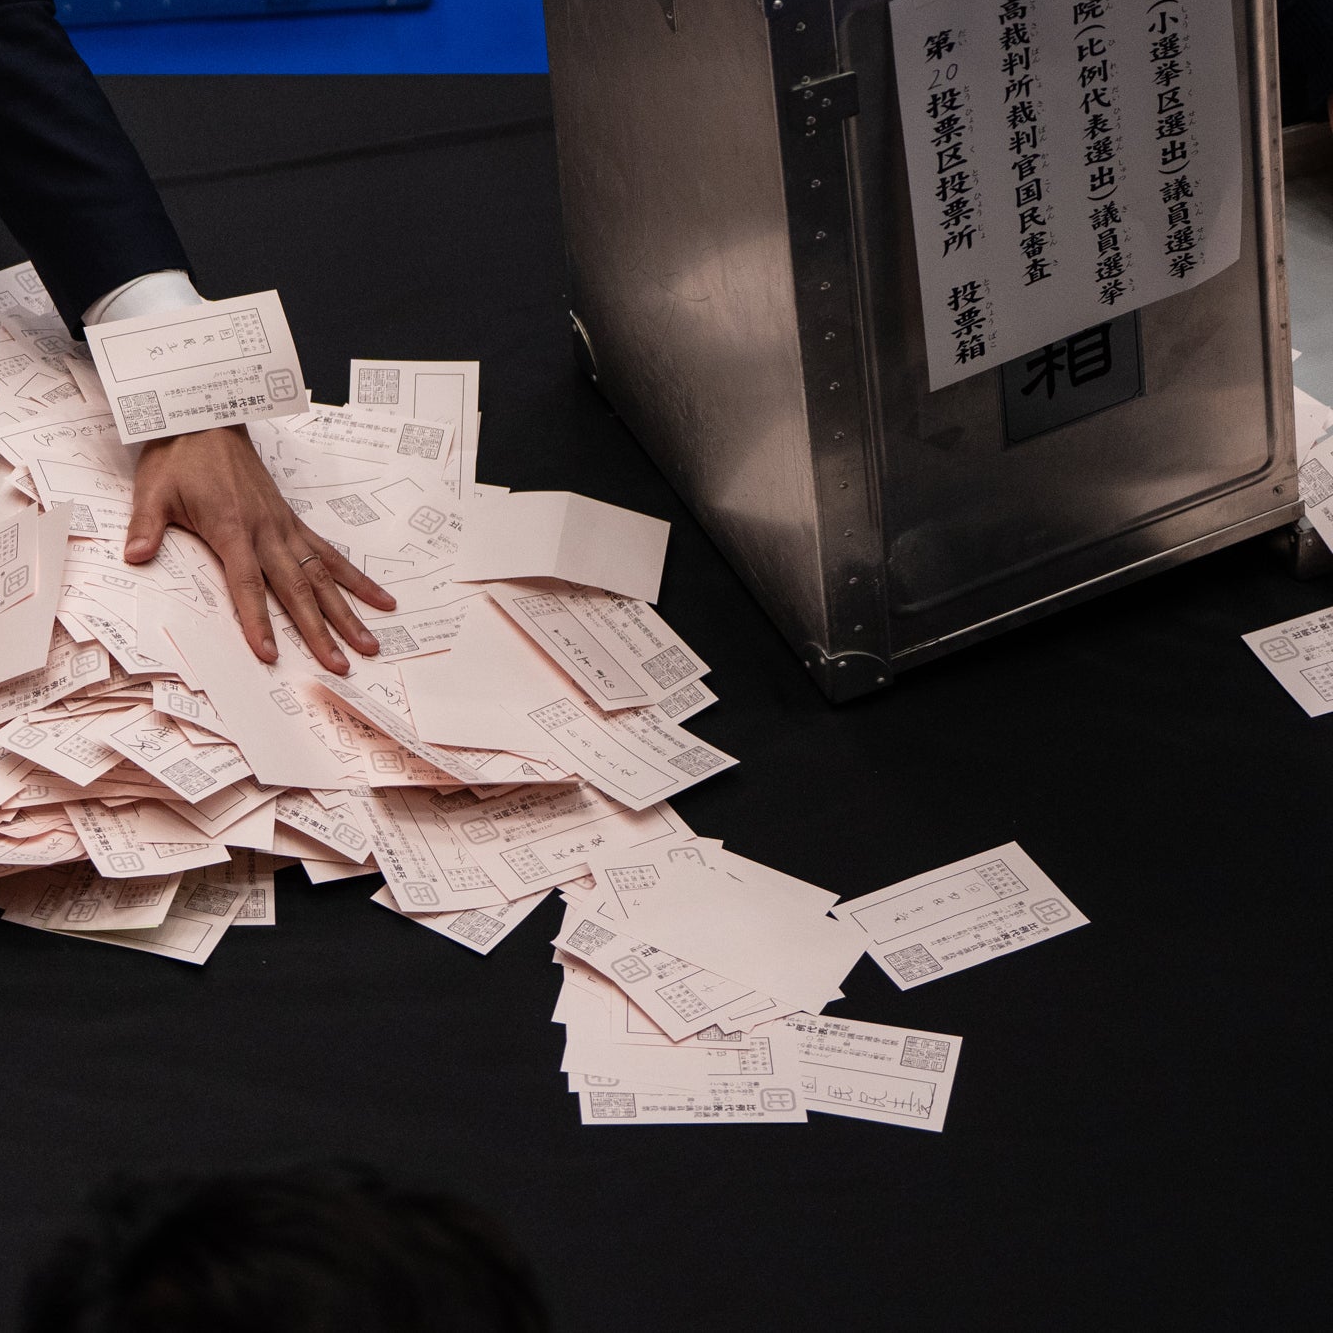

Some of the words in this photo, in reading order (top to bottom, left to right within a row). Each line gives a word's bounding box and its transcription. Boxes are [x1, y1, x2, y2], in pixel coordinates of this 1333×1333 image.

[923, 30, 977, 257] 第20投票区投票所
[947, 281, 987, 365] 投票箱
